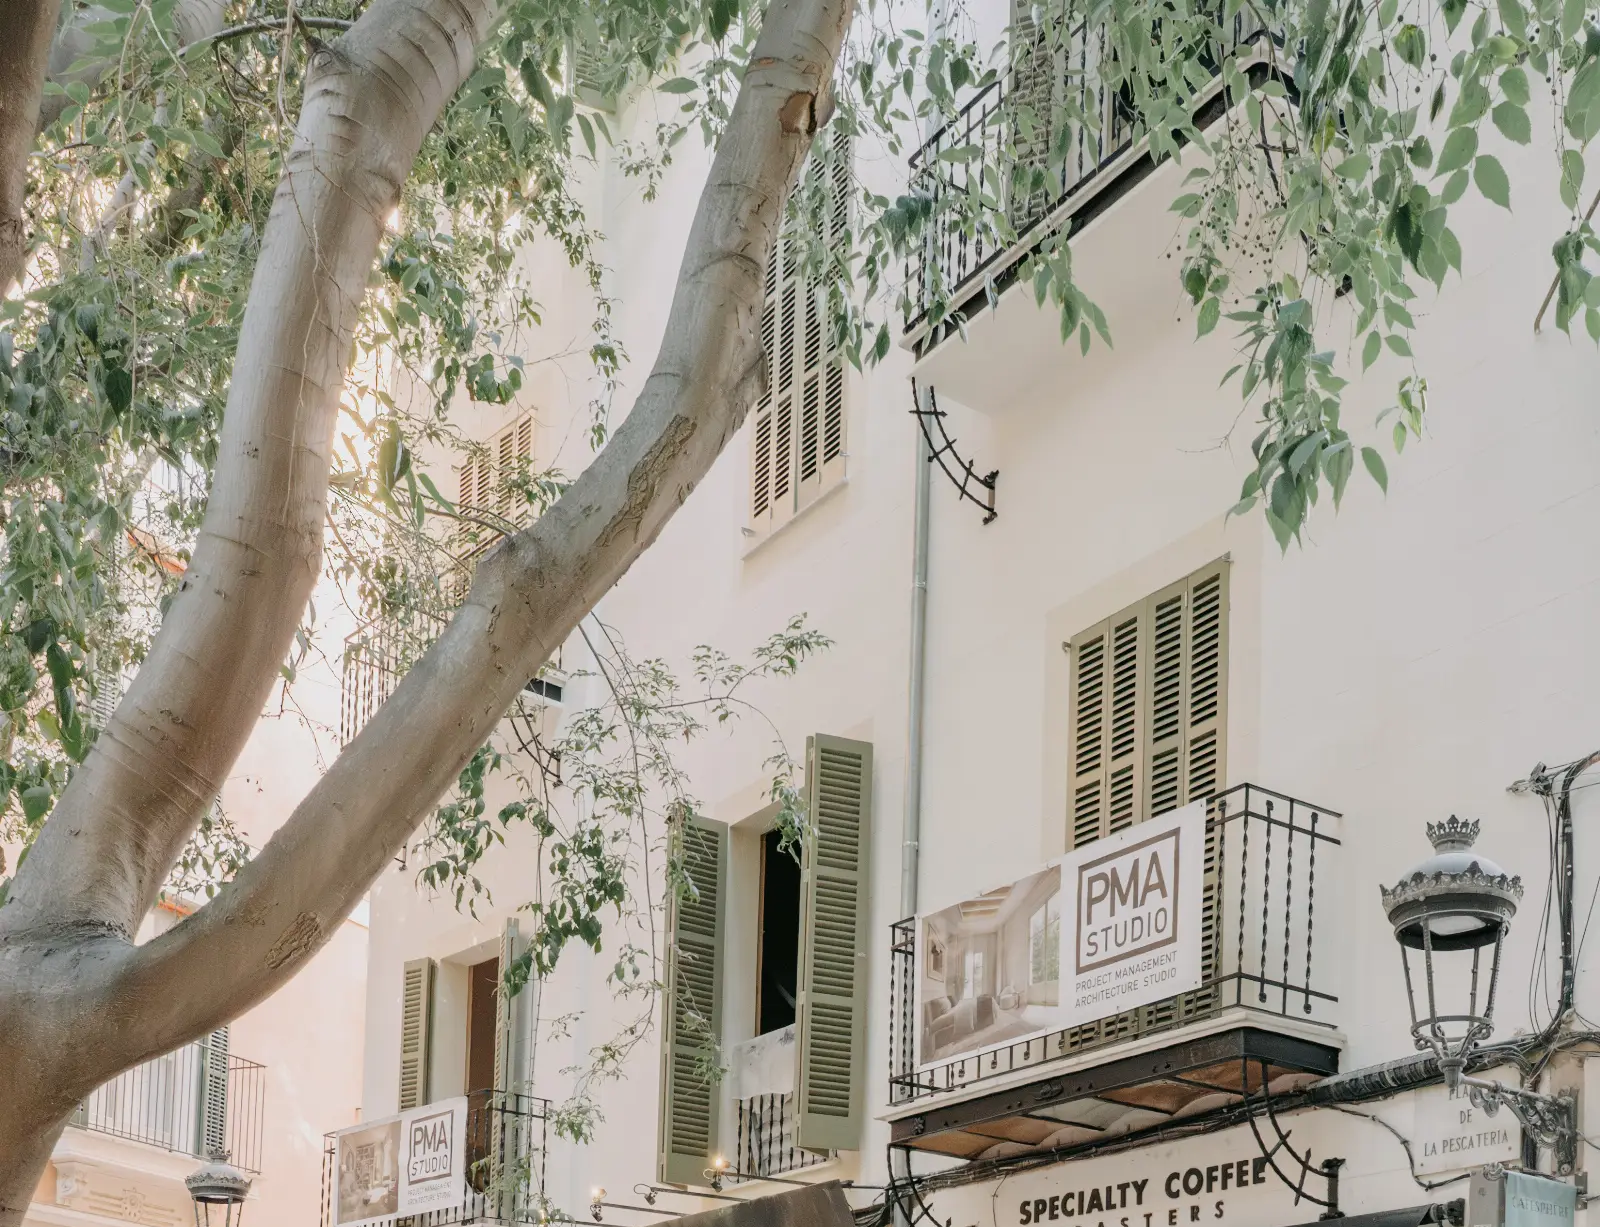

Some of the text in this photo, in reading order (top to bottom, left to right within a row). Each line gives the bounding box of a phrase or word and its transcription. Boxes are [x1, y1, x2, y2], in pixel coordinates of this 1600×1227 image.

[1087, 851, 1168, 926] PMA
[1086, 907, 1168, 957] STUDIO
[1075, 951, 1177, 993] PROJECT MANAGEMENT
[1075, 967, 1177, 1009] ARCHITECTURE STUDIO
[1460, 1109, 1473, 1124] DE
[413, 1120, 449, 1158] PMA
[1424, 1142, 1437, 1157] LA
[411, 1154, 449, 1177] STUDIO
[1019, 1156, 1268, 1225] SPECIALTY COFFEE
